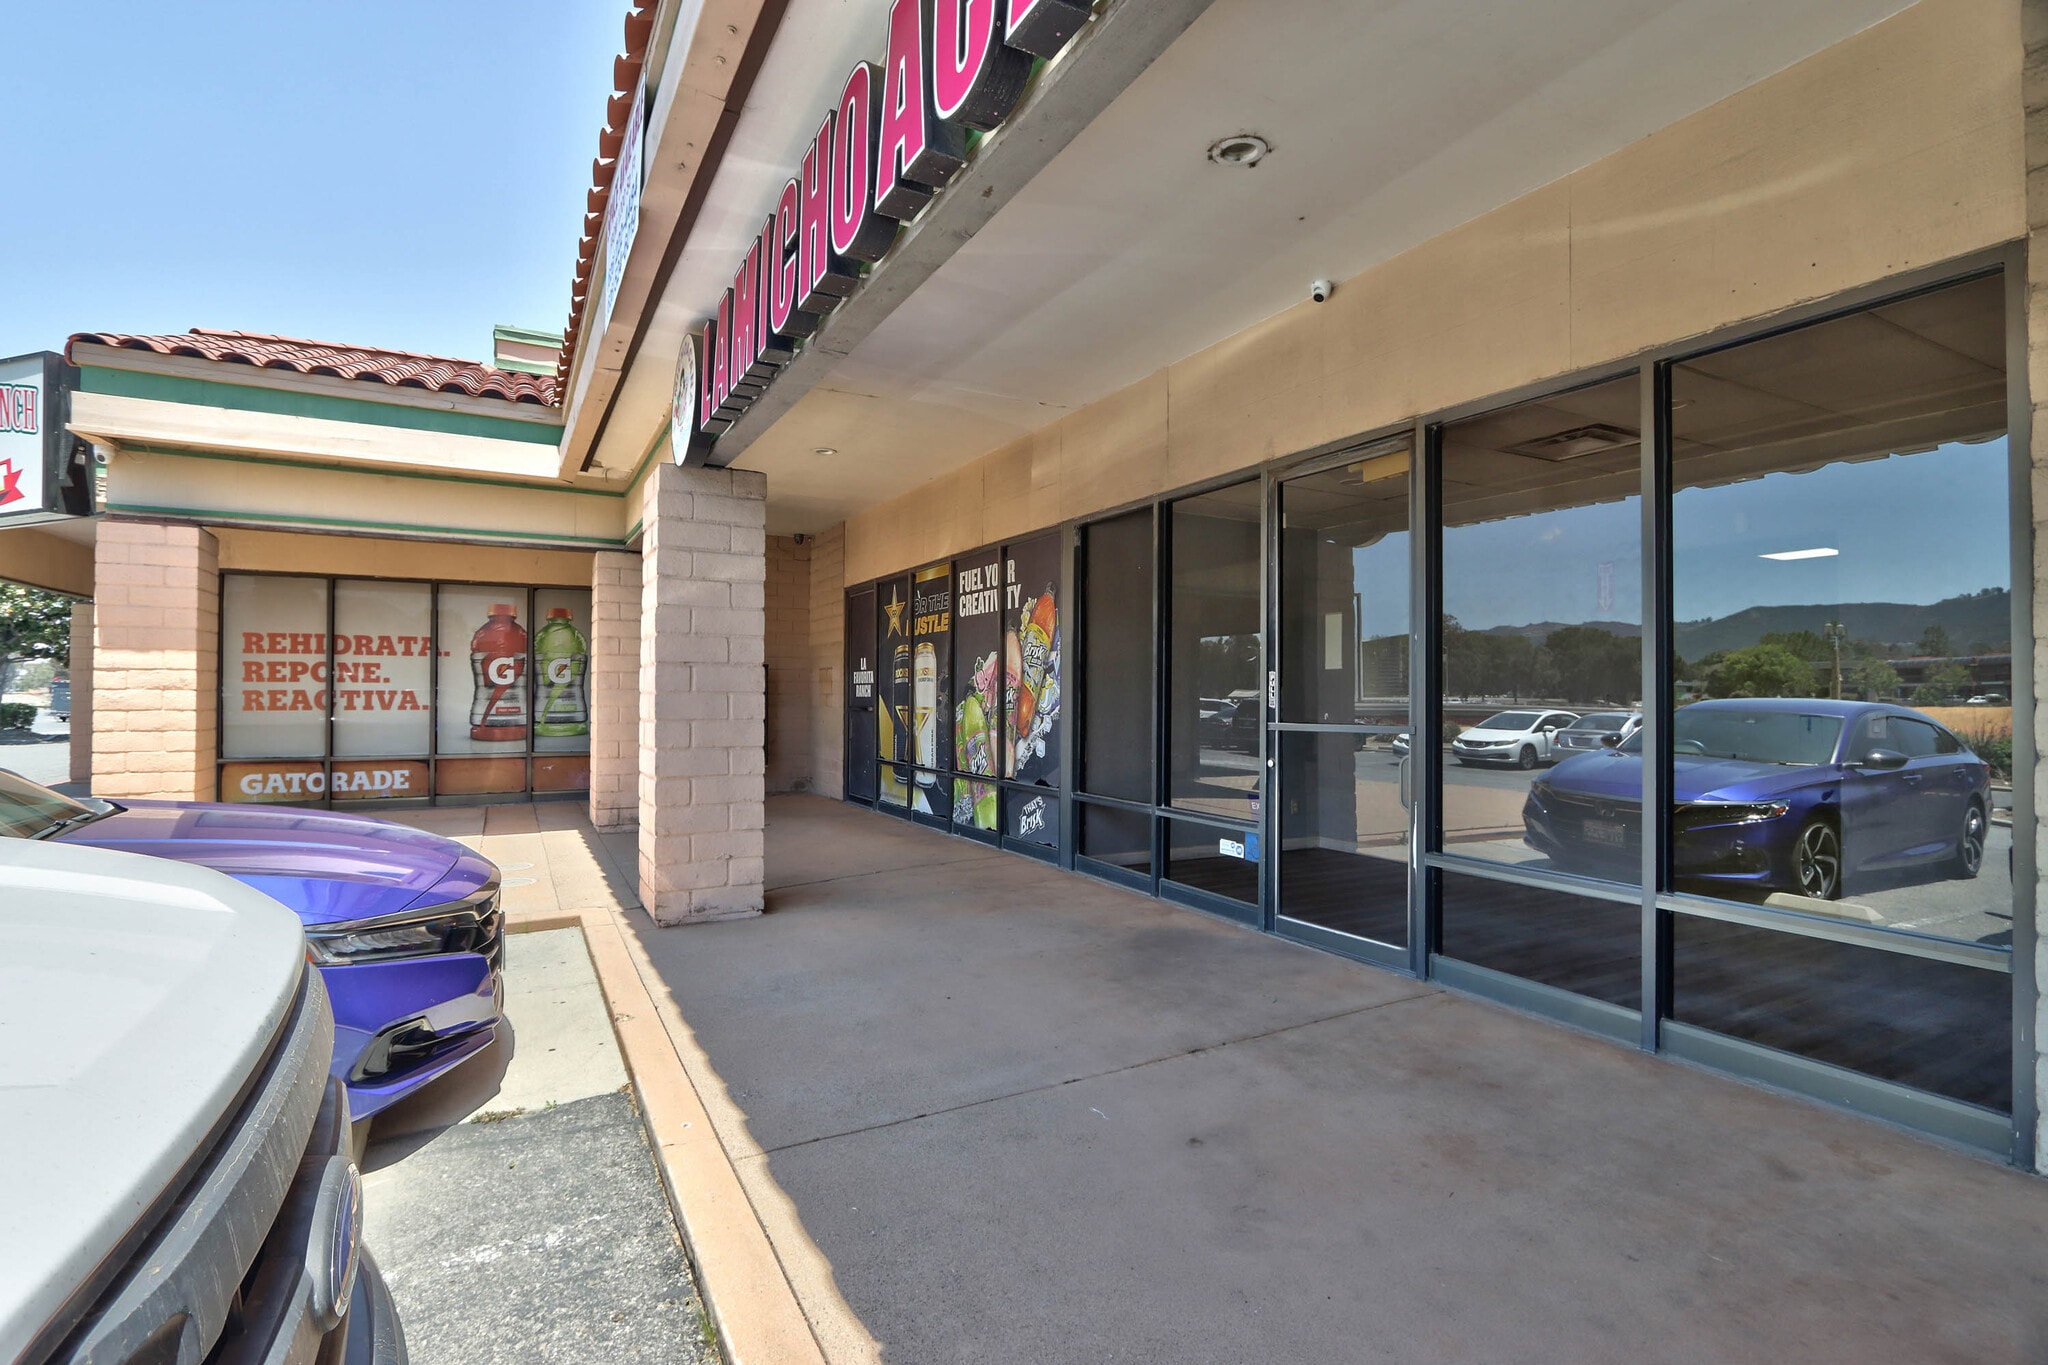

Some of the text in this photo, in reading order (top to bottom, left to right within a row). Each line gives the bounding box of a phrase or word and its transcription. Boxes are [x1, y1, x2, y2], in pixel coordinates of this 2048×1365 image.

[960, 560, 1016, 593] FUEL YOR
[960, 584, 1021, 617] CREATITY
[242, 632, 450, 657] REHIDRATA.
[242, 661, 390, 683] REPONE.
[488, 657, 515, 685] G
[547, 657, 572, 684] G
[242, 690, 429, 711] REACTIVA.
[240, 770, 410, 795] GATORADE
